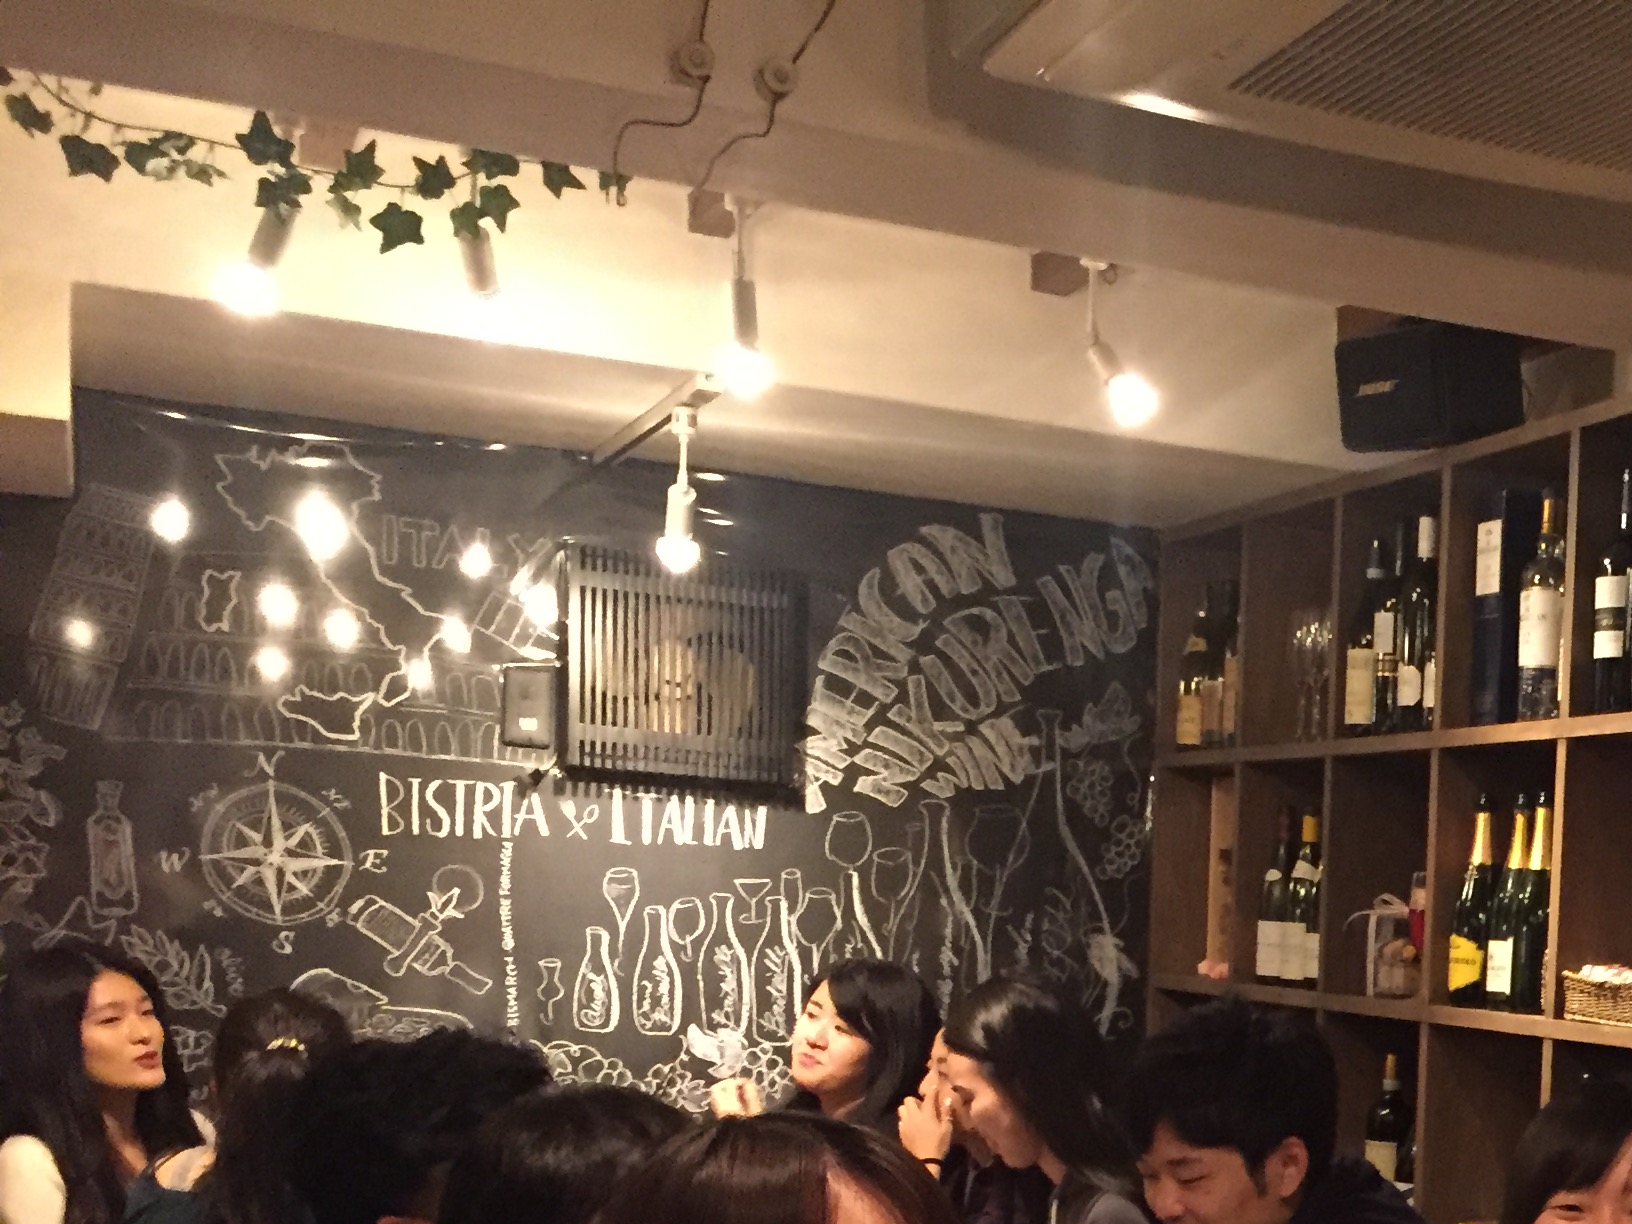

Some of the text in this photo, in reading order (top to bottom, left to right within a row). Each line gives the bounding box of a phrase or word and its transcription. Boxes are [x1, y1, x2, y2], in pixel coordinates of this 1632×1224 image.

[379, 771, 768, 851] BISTRIA ITALIAN
[359, 849, 389, 874] E
[272, 931, 295, 954] S
